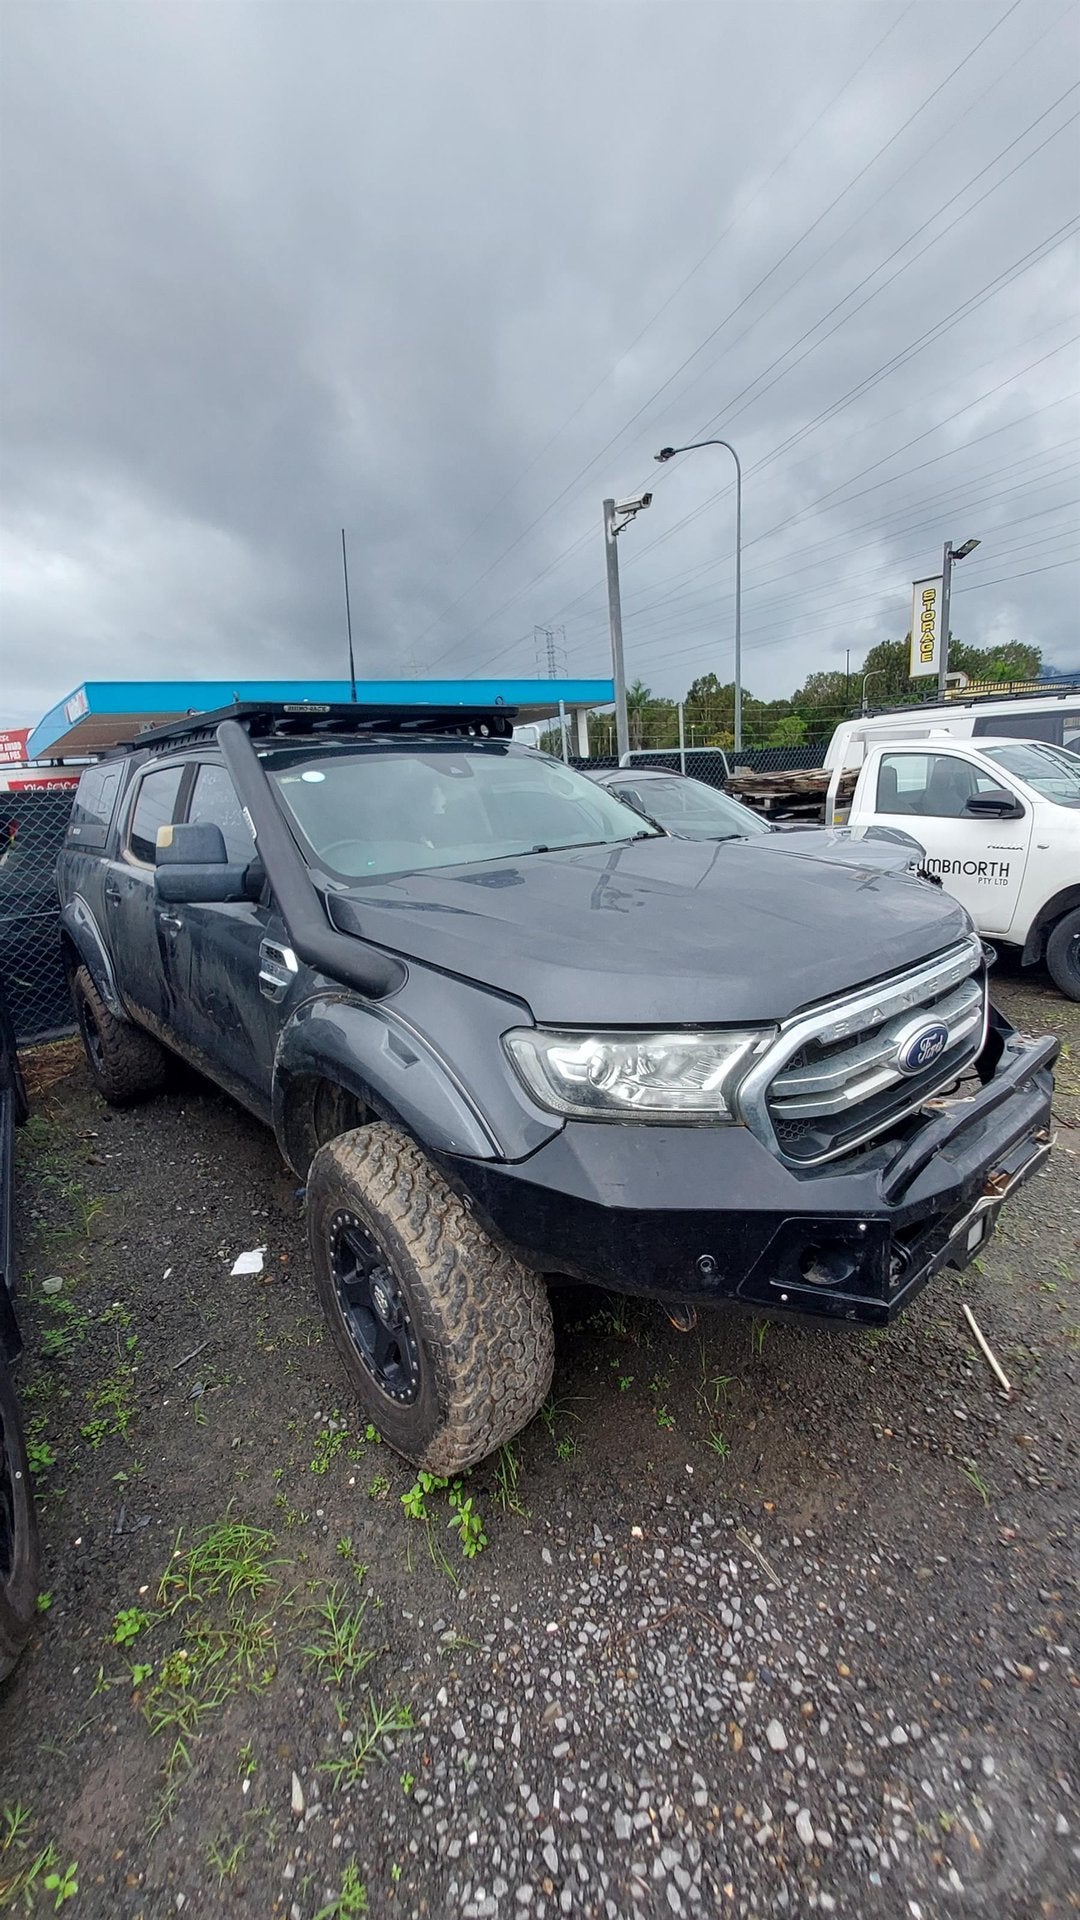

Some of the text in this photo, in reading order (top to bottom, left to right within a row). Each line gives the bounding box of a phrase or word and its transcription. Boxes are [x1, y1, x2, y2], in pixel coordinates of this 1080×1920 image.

[920, 588, 936, 663] STORAGE
[977, 877, 1009, 886] PTY LTD
[917, 1032, 944, 1064] Ford
